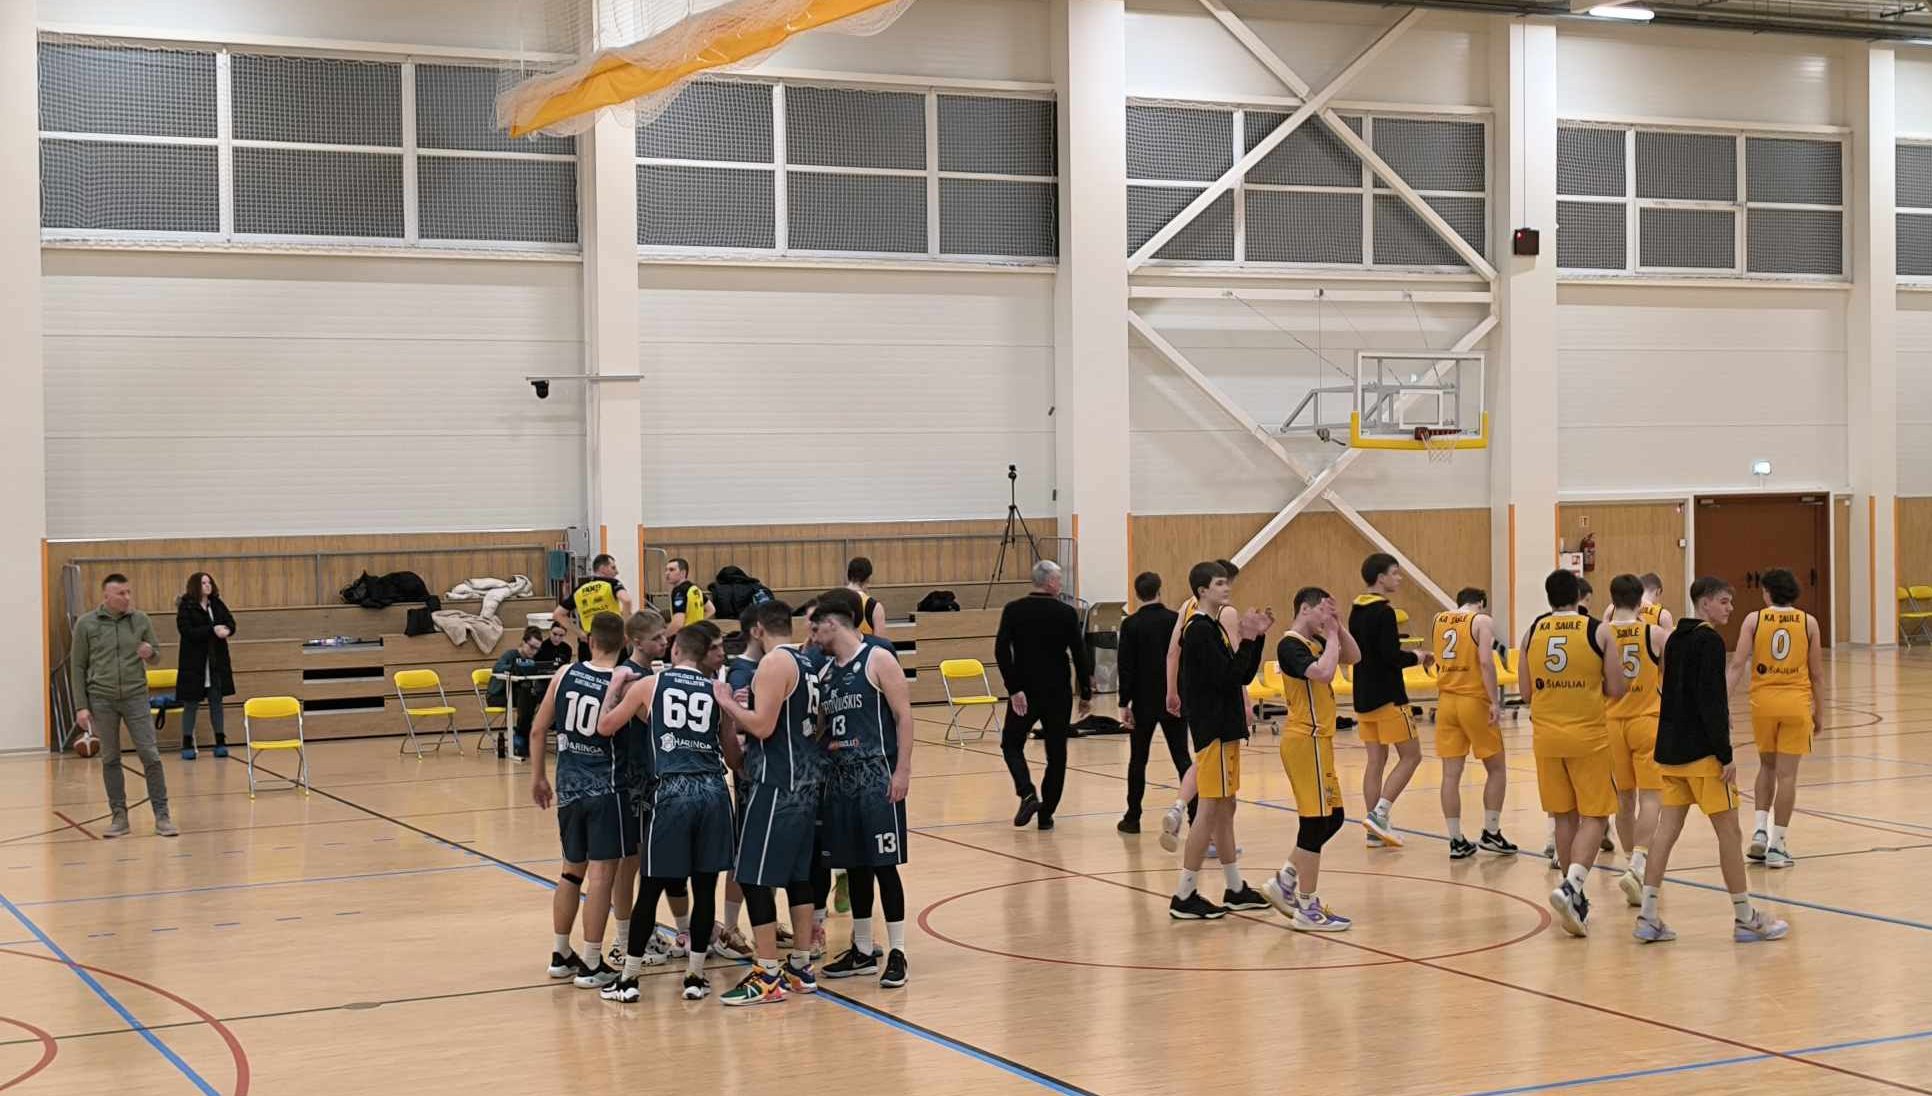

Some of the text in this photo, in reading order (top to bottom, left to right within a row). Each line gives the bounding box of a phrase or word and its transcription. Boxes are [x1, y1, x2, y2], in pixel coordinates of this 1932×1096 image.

[1539, 620, 1551, 630] KA
[1764, 613, 1775, 622] KA
[1441, 628, 1458, 660] 2
[1544, 635, 1569, 673] 5
[1771, 628, 1791, 660] 0
[565, 690, 601, 738] 10
[662, 687, 714, 733] 69
[832, 714, 847, 737] 13
[874, 832, 897, 854] 13
